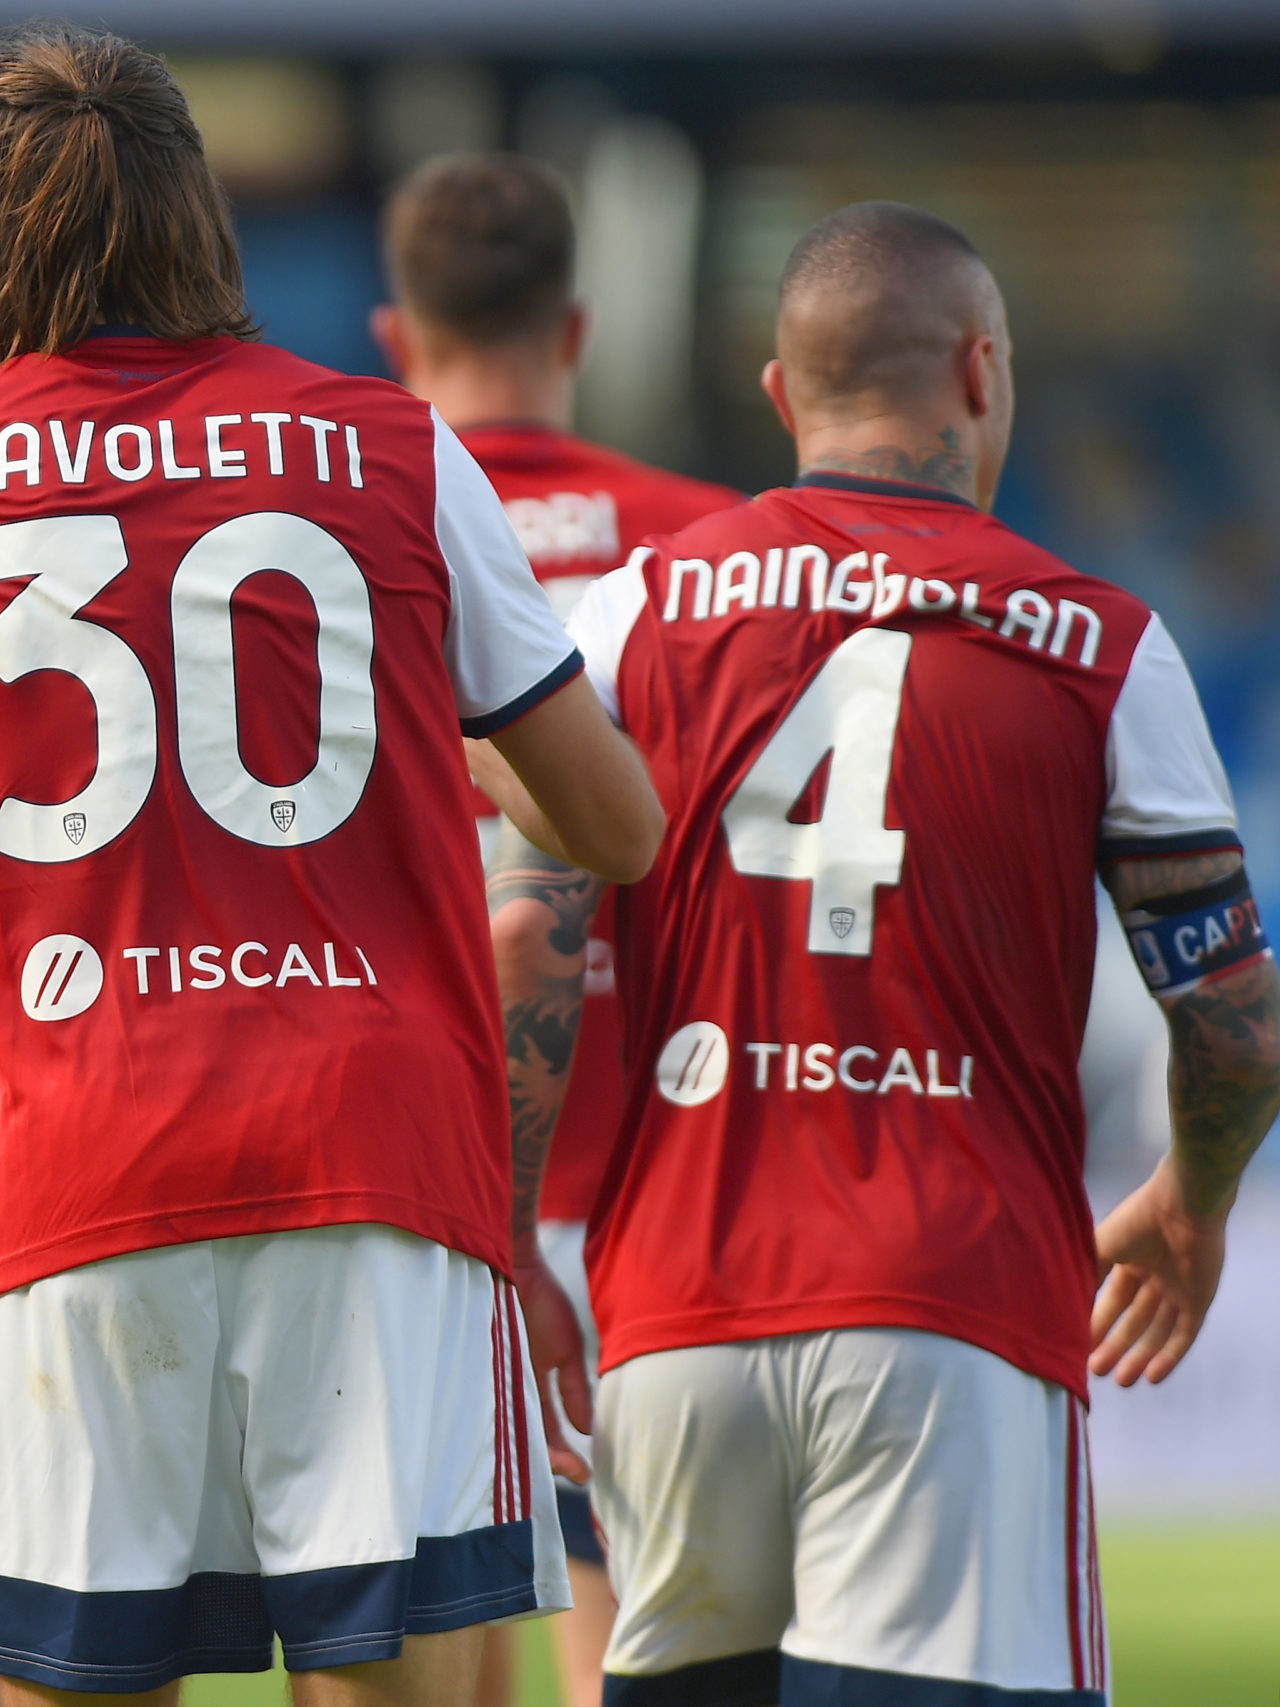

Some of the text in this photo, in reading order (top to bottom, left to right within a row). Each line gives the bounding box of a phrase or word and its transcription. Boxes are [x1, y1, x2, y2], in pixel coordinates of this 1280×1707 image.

[723, 627, 912, 956] 4
[123, 941, 378, 994] TISCALI
[746, 1041, 974, 1098] TISCALI
